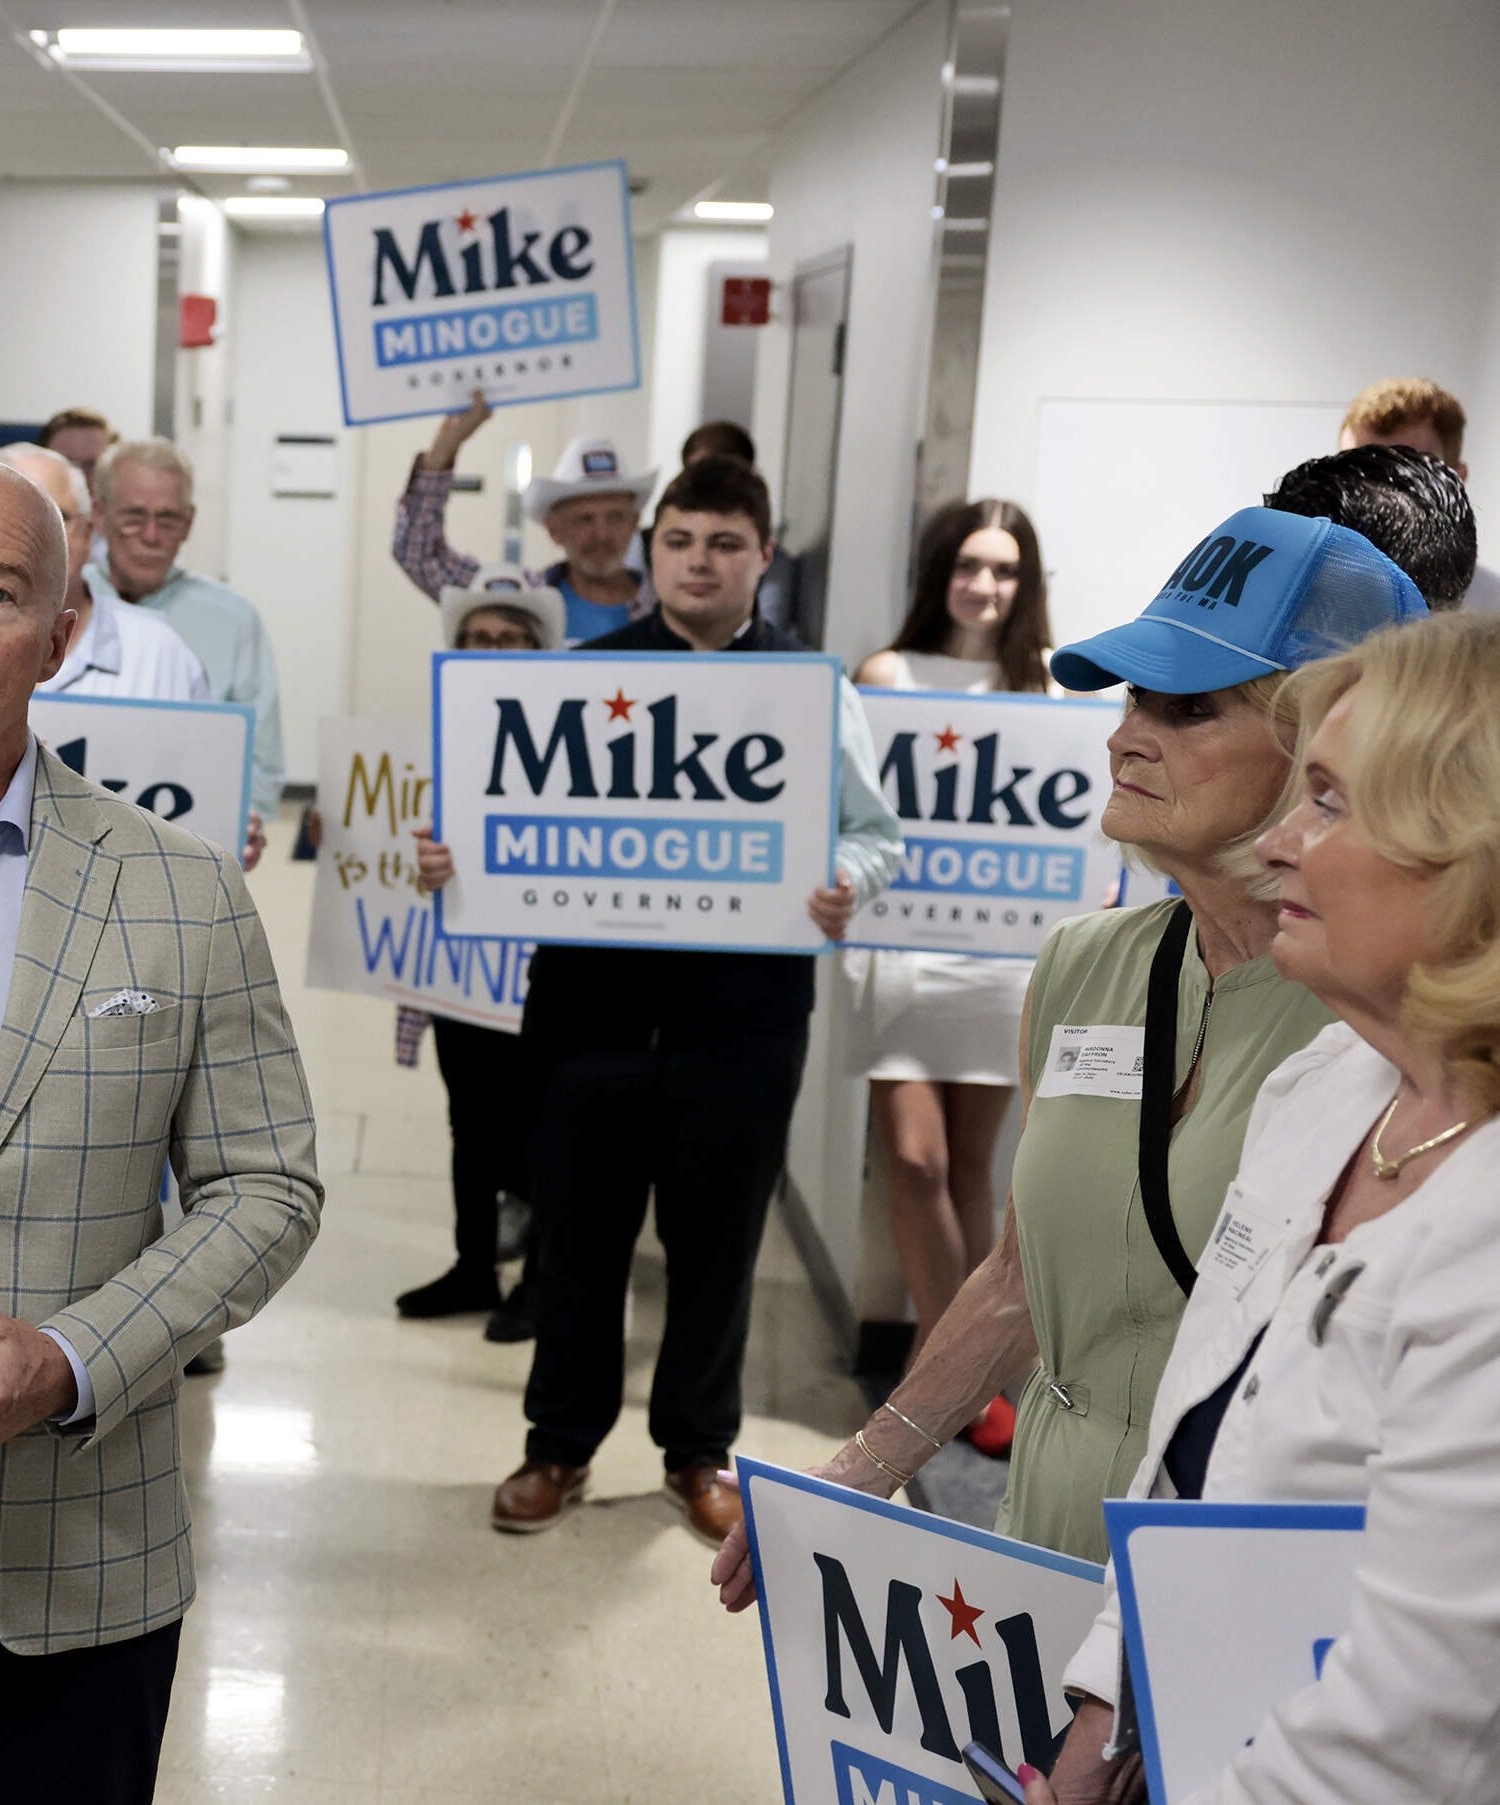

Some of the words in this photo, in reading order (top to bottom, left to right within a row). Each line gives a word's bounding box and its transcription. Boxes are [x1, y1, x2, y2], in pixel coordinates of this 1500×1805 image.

[372, 206, 596, 307] Mike
[383, 302, 589, 361] MINOGUE
[485, 687, 786, 803] Mike
[880, 724, 1092, 829] Mike
[496, 823, 771, 873] MINOGUE
[893, 845, 1073, 893] NOGUE
[523, 889, 743, 914] GOVERNOR
[872, 901, 1044, 927] OVERNOR
[356, 897, 539, 1005] WINNE
